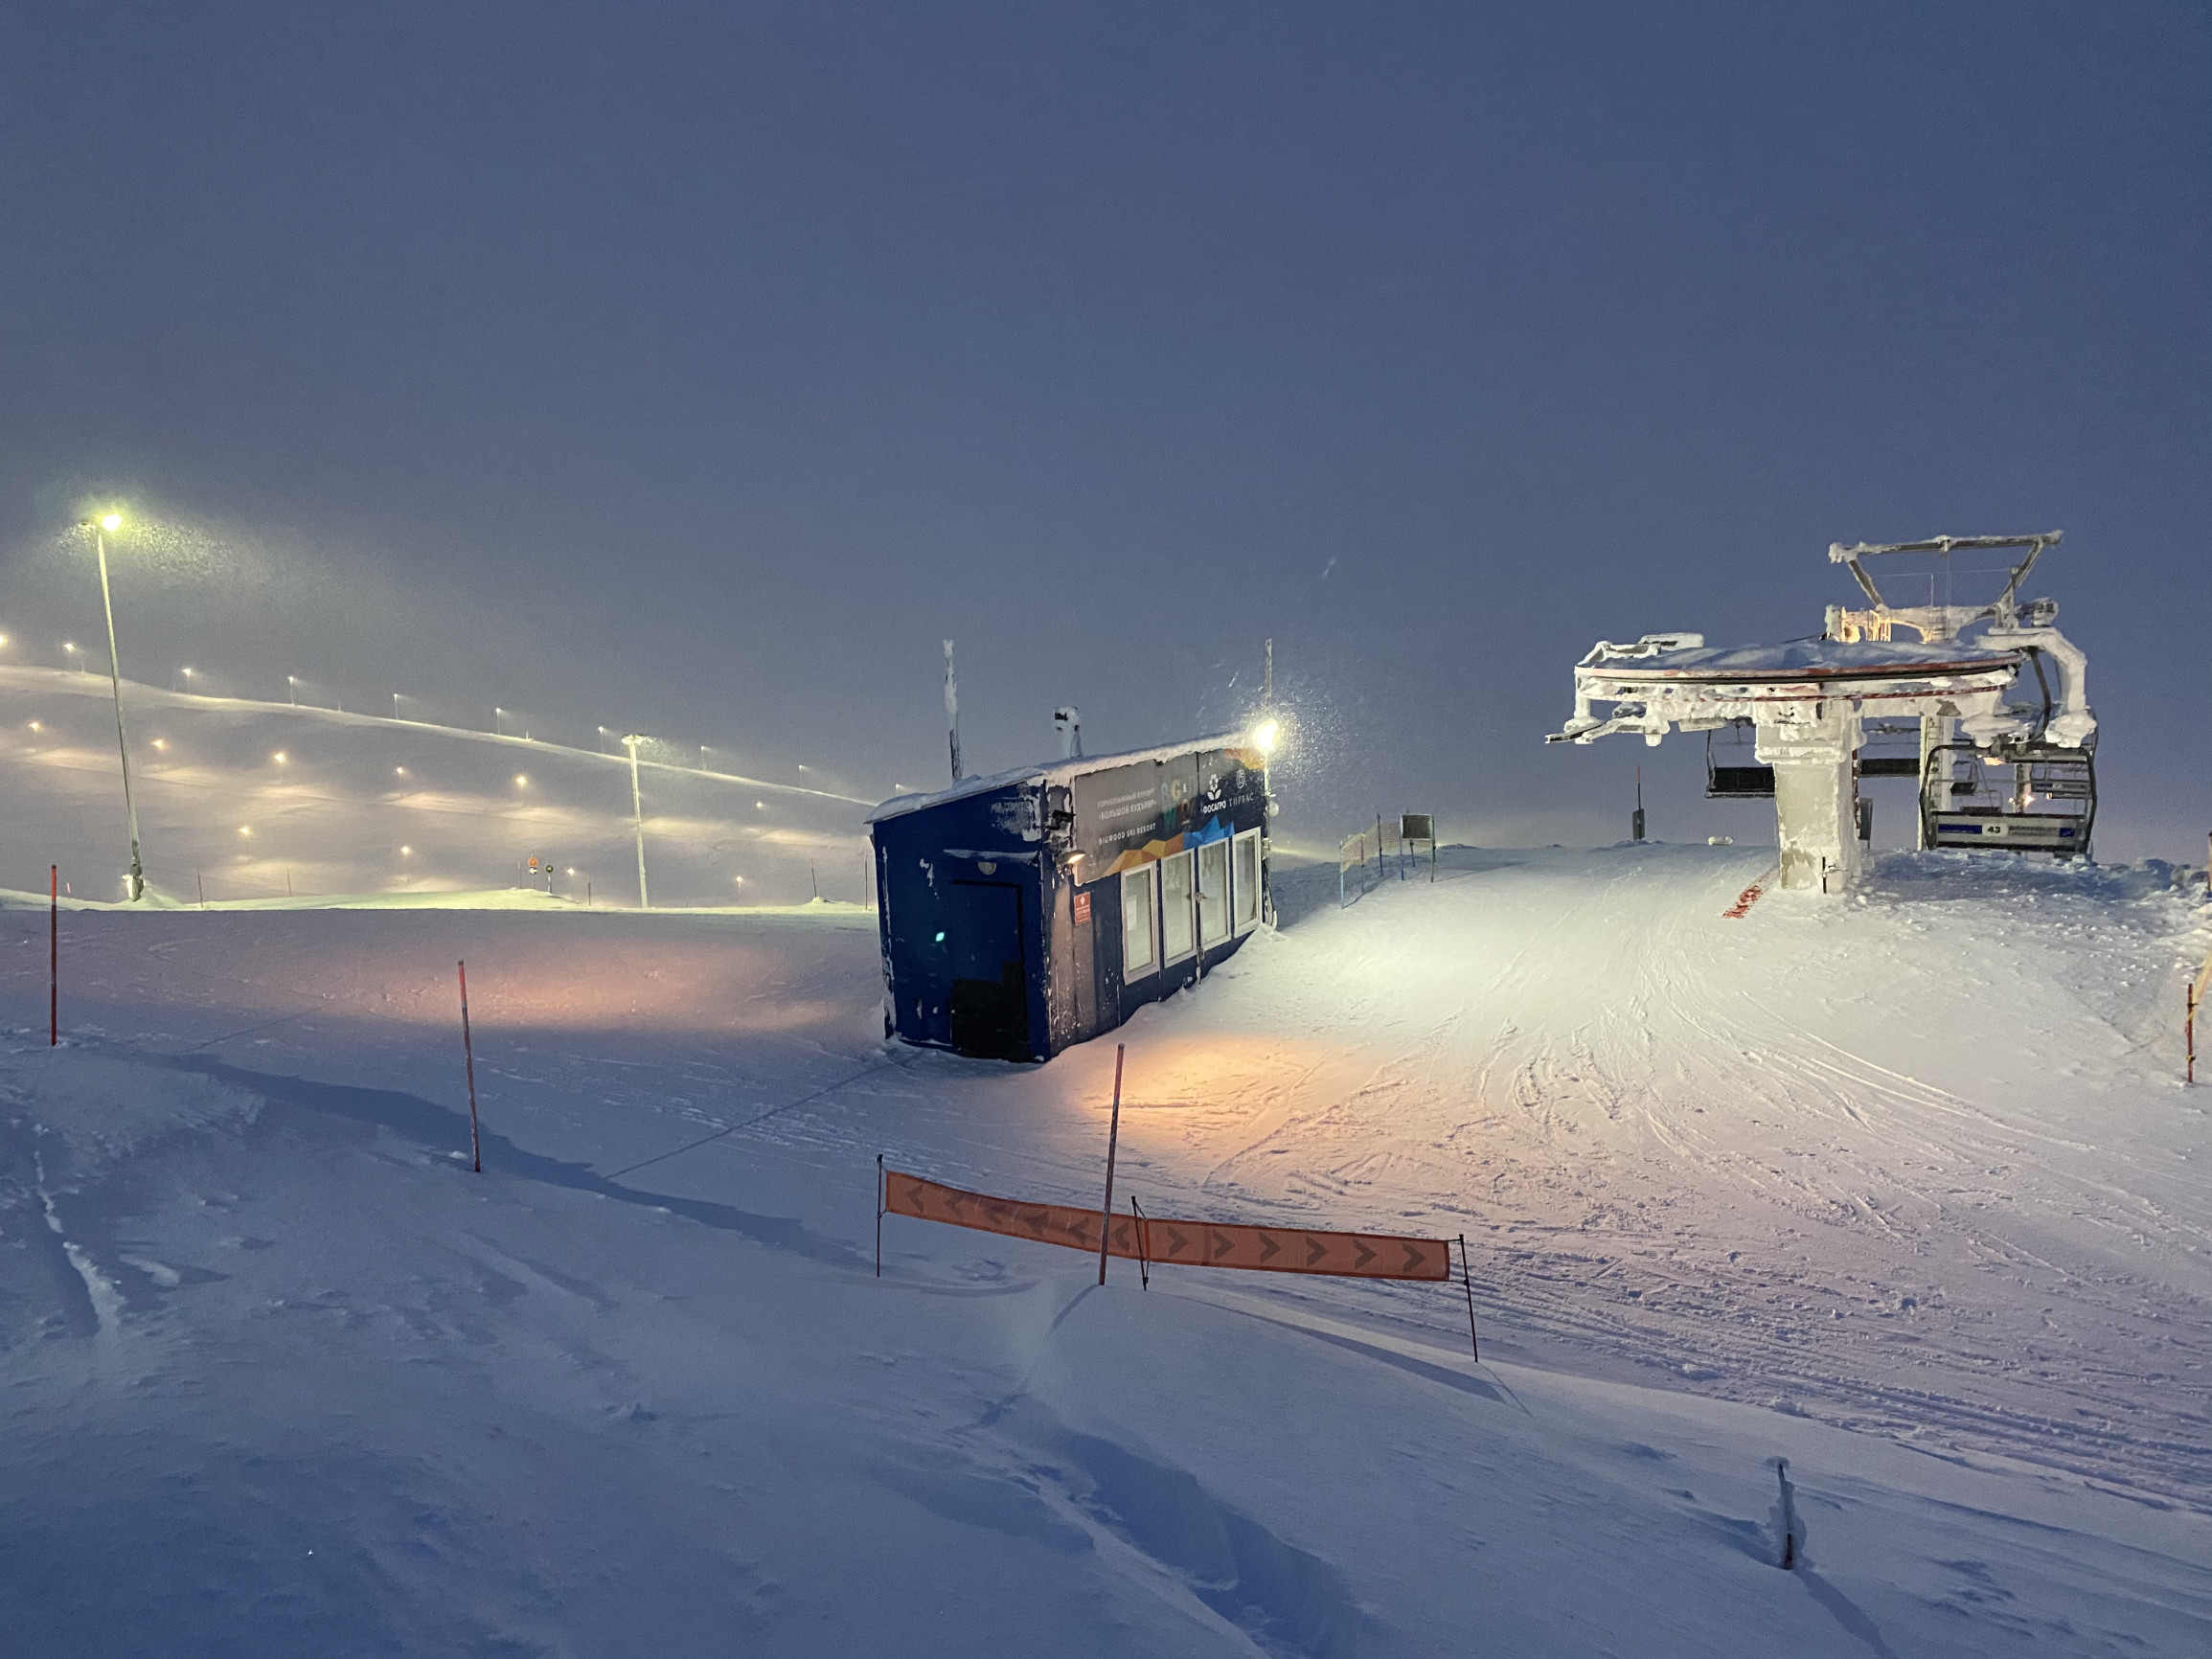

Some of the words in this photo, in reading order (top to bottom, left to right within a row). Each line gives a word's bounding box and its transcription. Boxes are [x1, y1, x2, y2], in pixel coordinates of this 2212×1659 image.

[1203, 800, 1226, 814] ФОСАГРО
[1099, 831, 1126, 846] BIGWOOD
[1137, 823, 1156, 834] RESORT
[1987, 826, 2000, 834] 43
